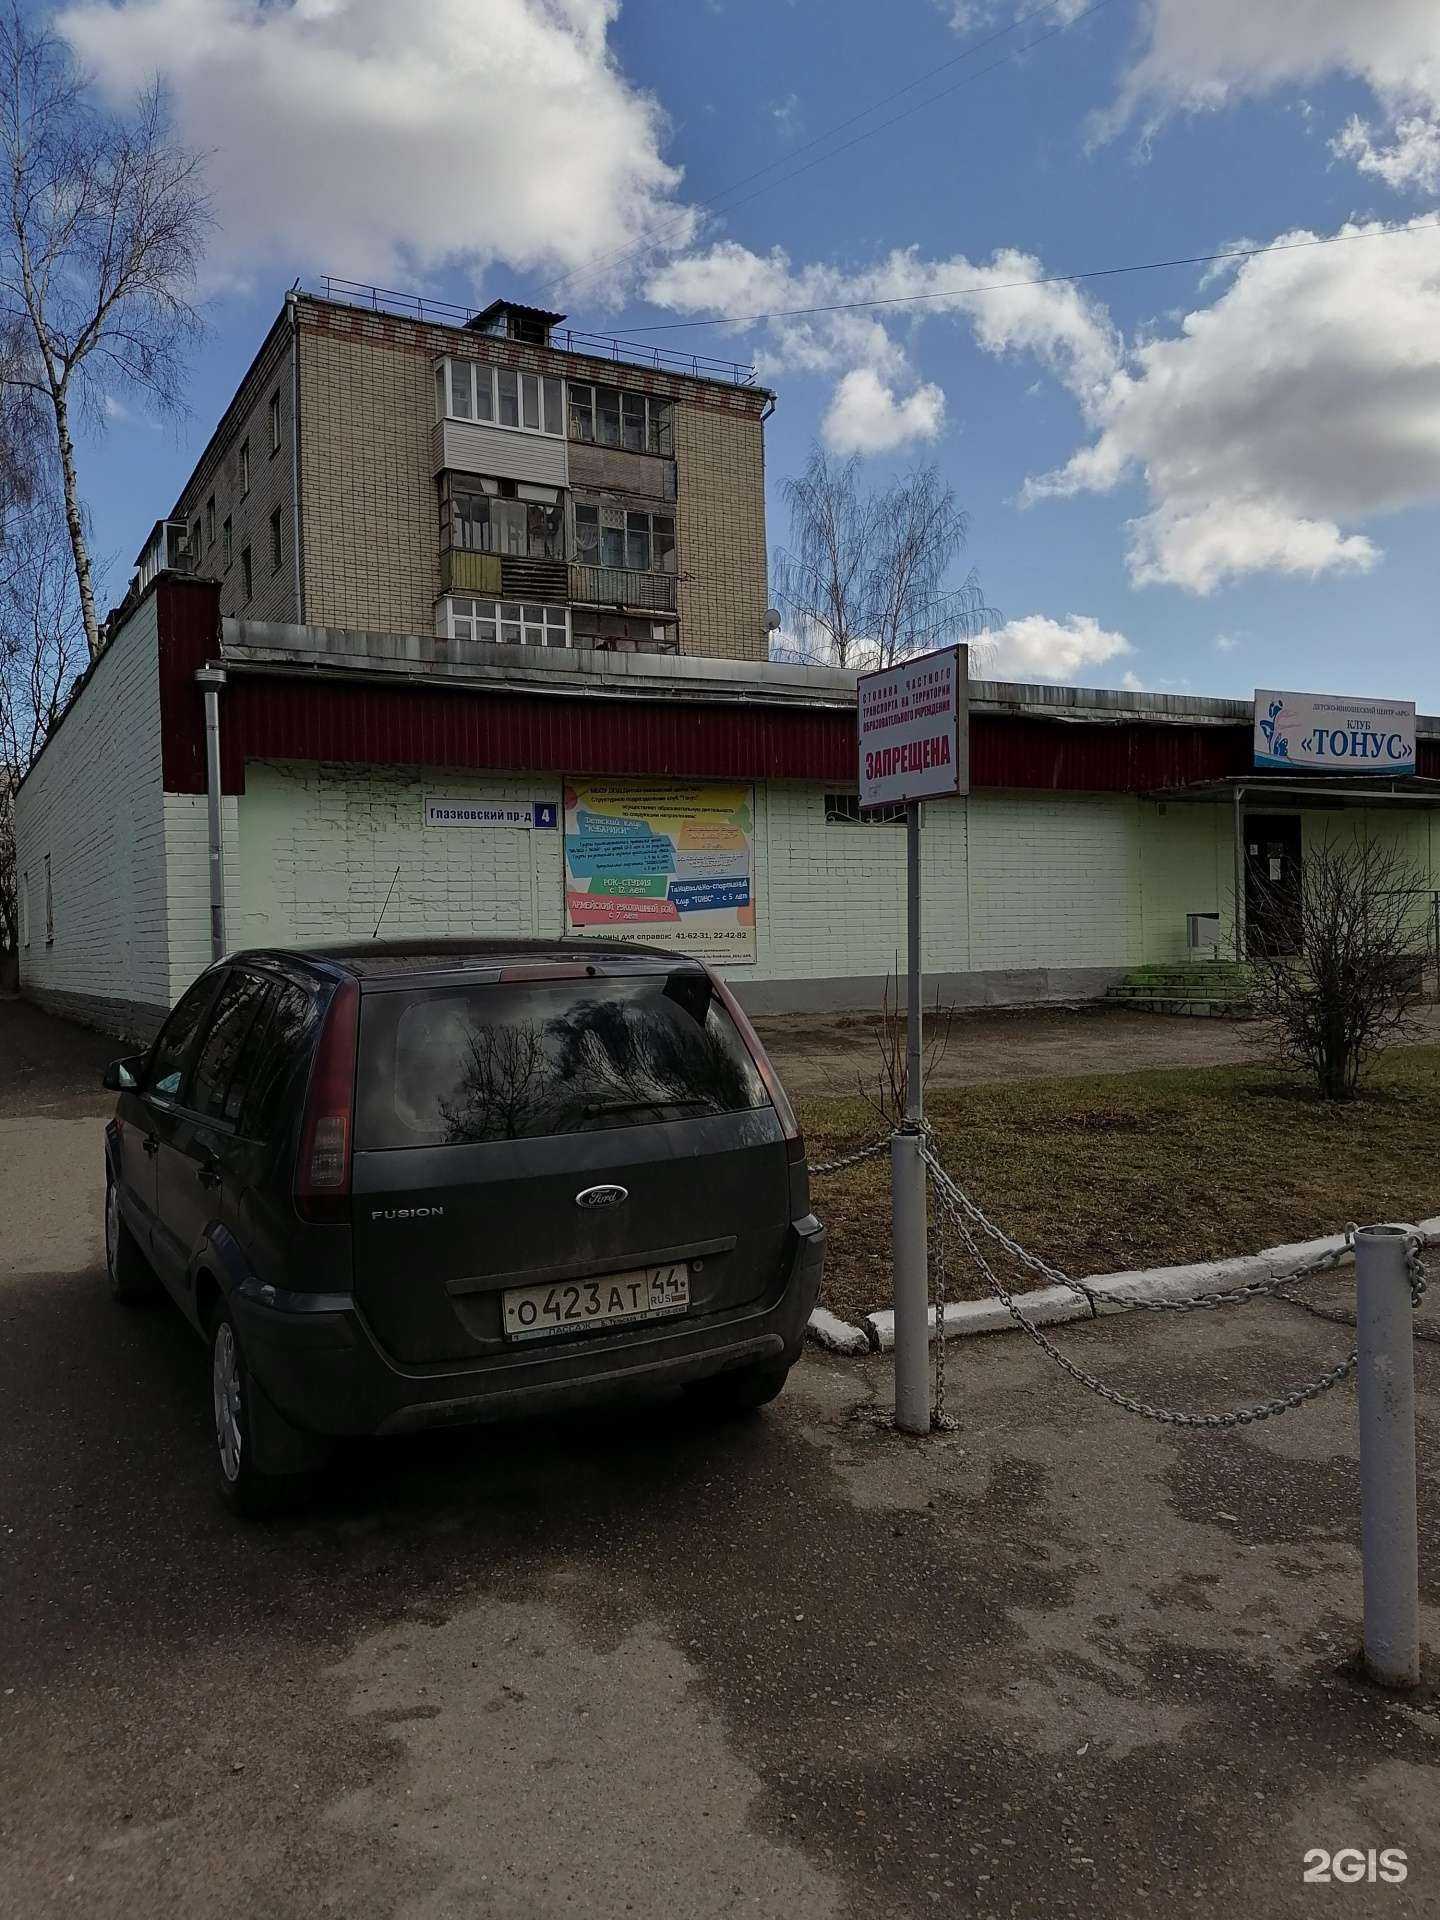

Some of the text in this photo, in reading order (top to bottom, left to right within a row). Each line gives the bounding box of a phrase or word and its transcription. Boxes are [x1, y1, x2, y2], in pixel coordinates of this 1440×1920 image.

[863, 667, 951, 704] СТОЯНКА ЧАСТНОГО
[863, 684, 951, 719] ТРАНСПОРТА НА ТЕРРИТОРИИ
[863, 709, 913, 733] ОБРАЗОВАТЕЛЬНОГО
[1346, 719, 1371, 730] КЛУБ
[1301, 729, 1413, 759] «ТОНУС»
[865, 734, 951, 781] ЗАПРЕЩЕНА
[430, 807, 550, 823] Глазковский пр-д 4
[621, 932, 635, 942] для
[370, 1206, 445, 1221] FUSION
[651, 1268, 680, 1295] 44
[650, 1294, 672, 1305] RUS
